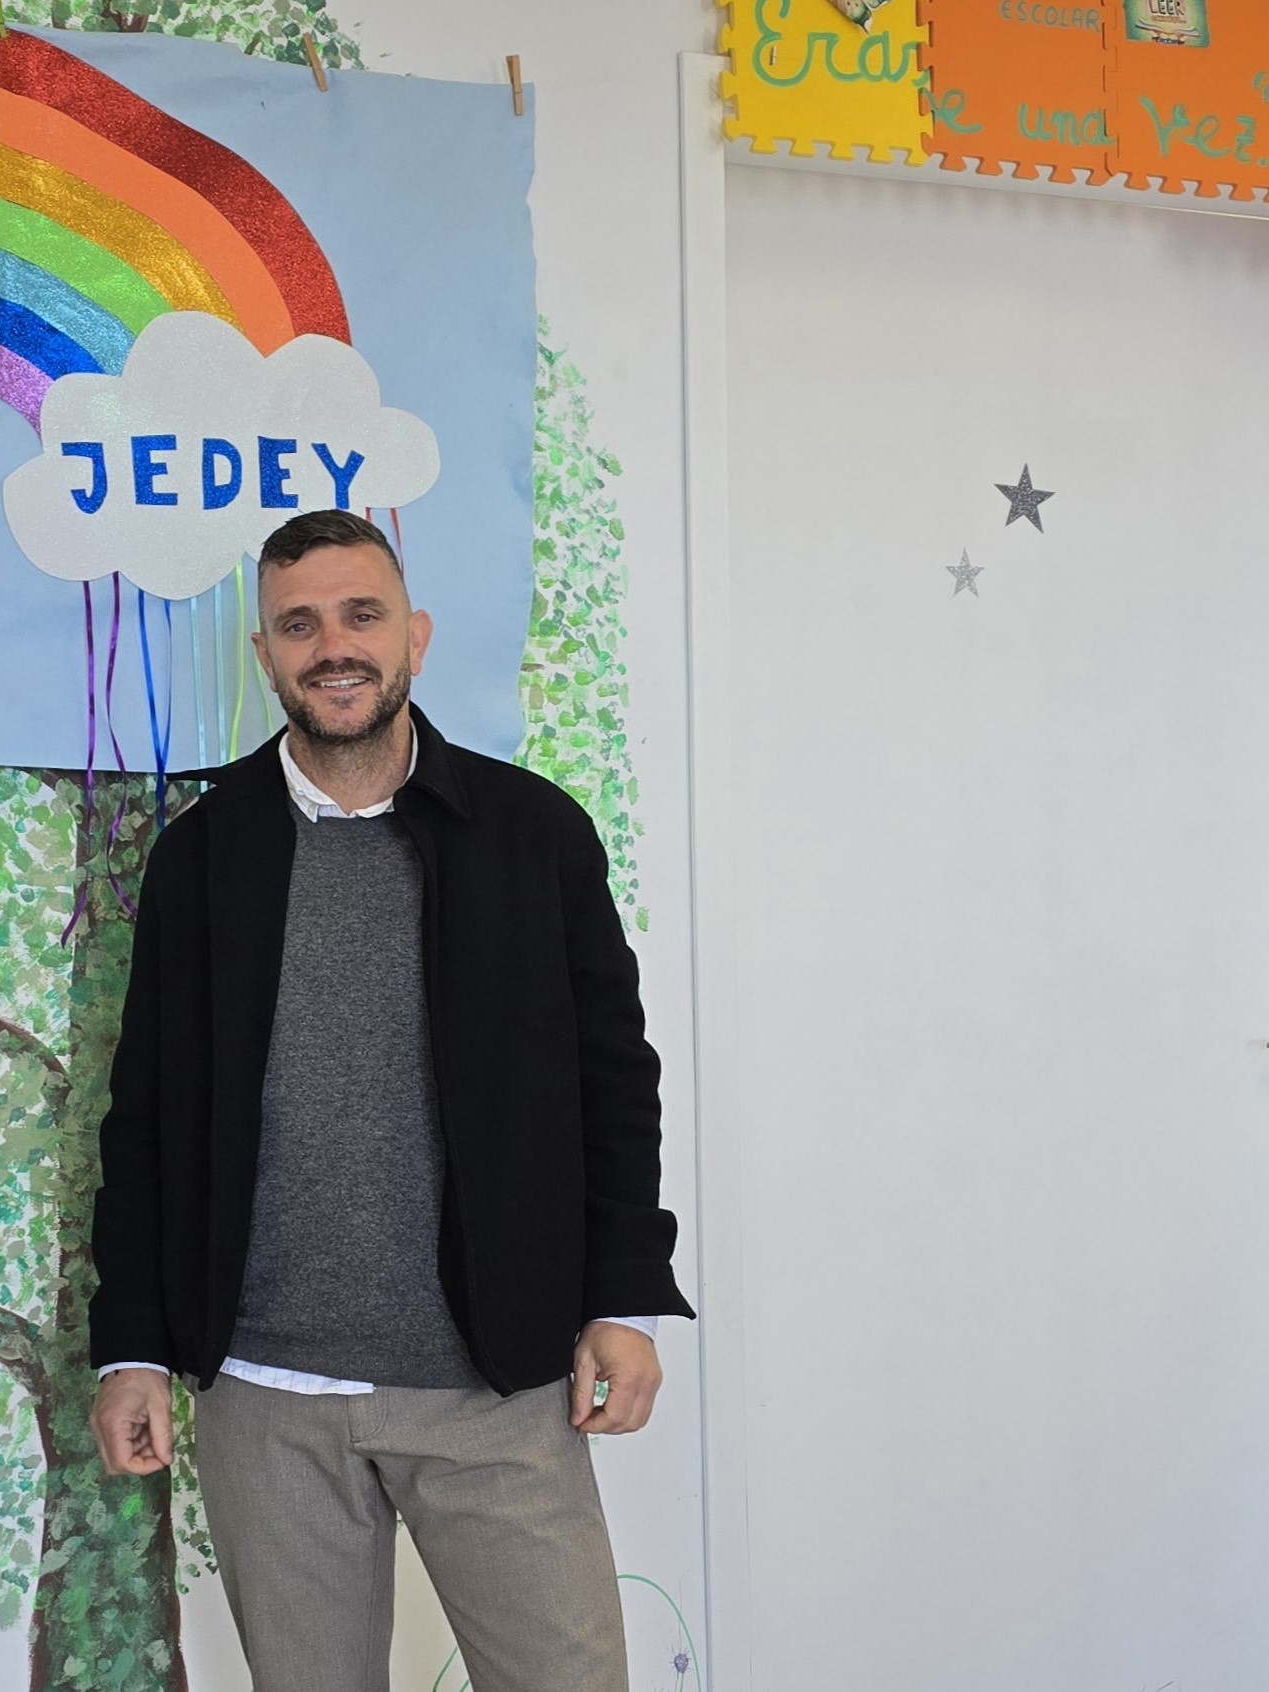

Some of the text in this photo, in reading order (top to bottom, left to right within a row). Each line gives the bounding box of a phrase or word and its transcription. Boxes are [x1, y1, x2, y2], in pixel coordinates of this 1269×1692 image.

[1000, 0, 1102, 33] ESCOLAR
[1019, 103, 1116, 147] una
[60, 434, 366, 515] JEDEY
